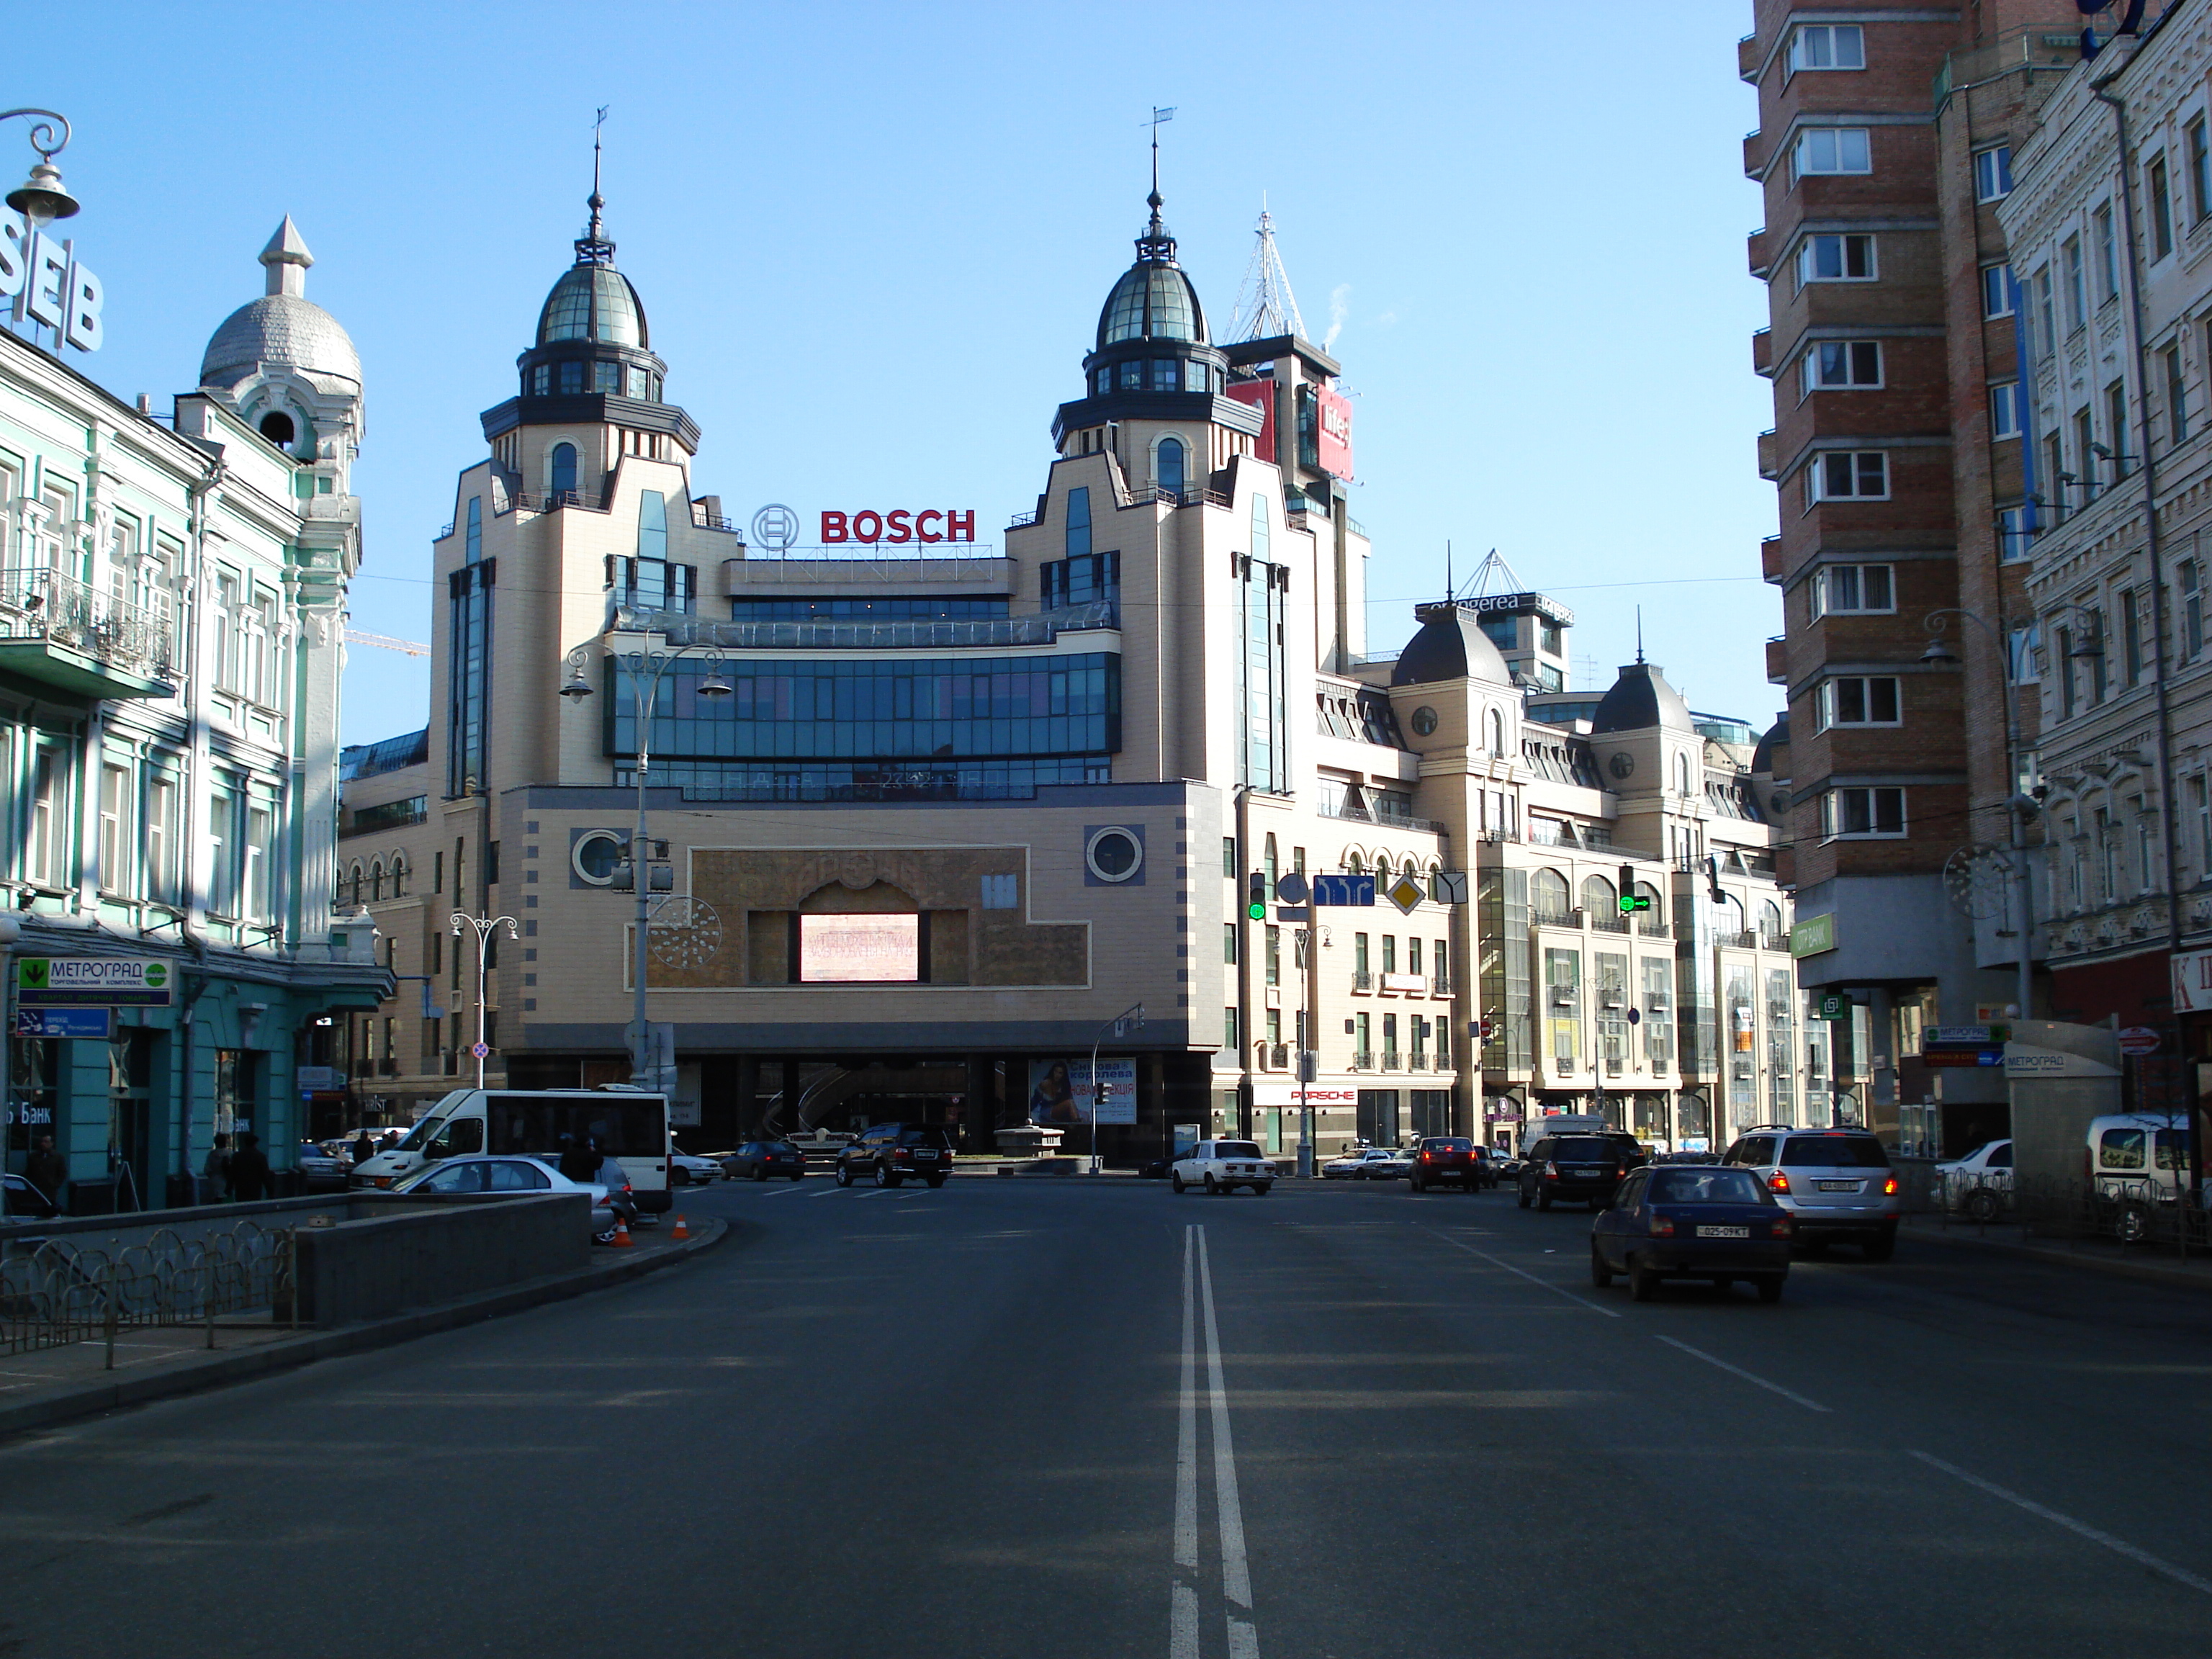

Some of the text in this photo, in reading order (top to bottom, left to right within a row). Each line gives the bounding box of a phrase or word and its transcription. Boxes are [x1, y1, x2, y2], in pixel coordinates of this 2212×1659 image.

[0, 205, 104, 352] SEB
[821, 509, 975, 544] BOSCH
[1430, 595, 1519, 612] orngerea
[1808, 922, 1826, 949] BANK
[51, 962, 143, 978] МЕТРОГРАД
[1070, 1062, 1120, 1071] Сніова
[2008, 1056, 2064, 1066] МЕТРОГРАД
[1070, 1070, 1133, 1081] королева
[1291, 1091, 1355, 1100] PORSCHE
[22, 1101, 51, 1124] Банк
